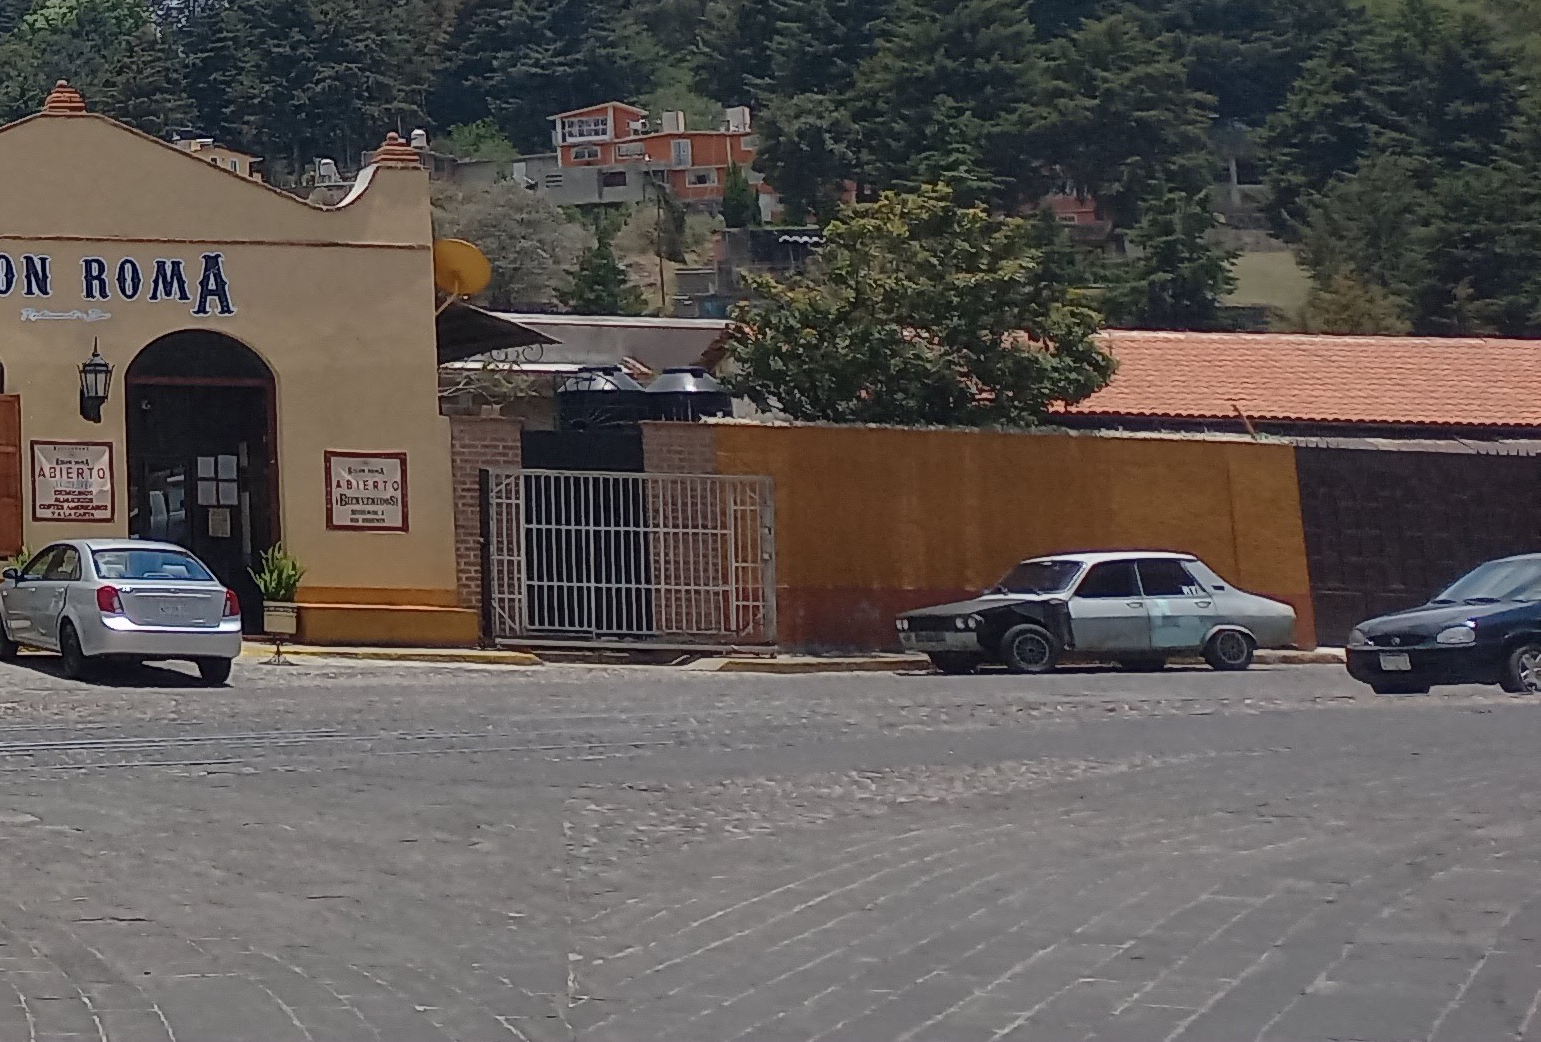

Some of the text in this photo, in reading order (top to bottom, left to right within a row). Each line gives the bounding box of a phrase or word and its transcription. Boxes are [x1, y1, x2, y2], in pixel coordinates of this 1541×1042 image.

[81, 252, 237, 317] ROMA
[38, 465, 106, 479] ABIERTO
[335, 479, 400, 491] ABIERTO
